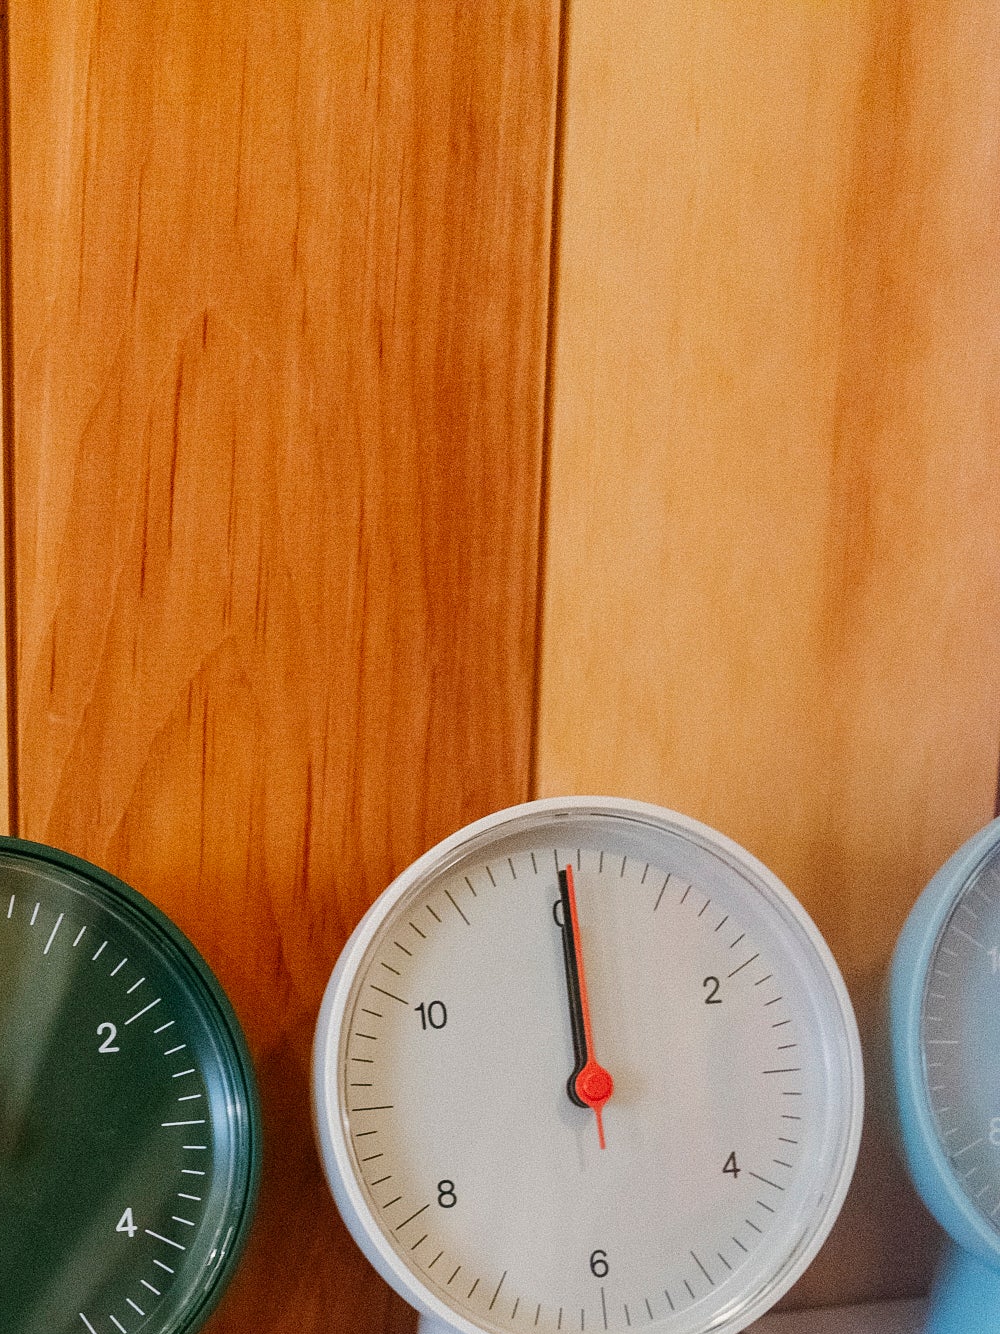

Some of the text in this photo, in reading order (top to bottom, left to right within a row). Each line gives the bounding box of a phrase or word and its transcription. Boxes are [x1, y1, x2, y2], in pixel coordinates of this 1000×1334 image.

[703, 976, 722, 1004] 2
[415, 1001, 447, 1029] 10
[97, 1023, 119, 1053] 2
[723, 1152, 740, 1178] 4
[438, 1180, 457, 1208] 8
[115, 1208, 137, 1237] 4
[590, 1250, 609, 1278] 6
